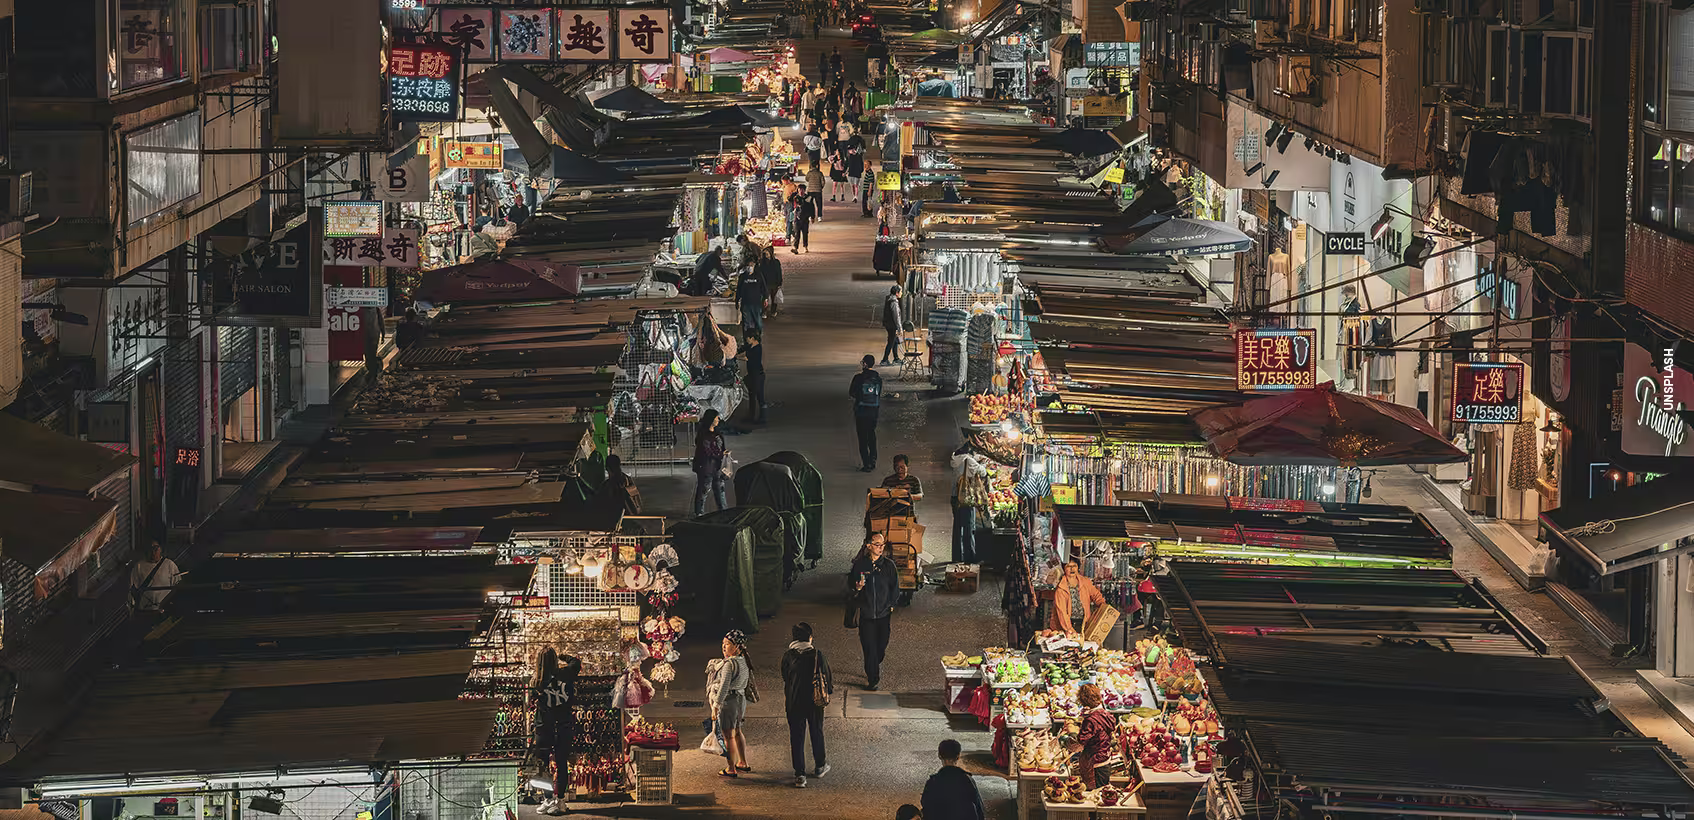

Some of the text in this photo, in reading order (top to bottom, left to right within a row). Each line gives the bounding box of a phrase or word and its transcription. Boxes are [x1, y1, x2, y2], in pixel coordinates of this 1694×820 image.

[389, 168, 407, 189] B
[1328, 237, 1364, 251] CYCLE
[1243, 335, 1290, 370] 美足樂
[1242, 371, 1311, 385] 91755993
[1455, 404, 1518, 420] 91755993
[1635, 376, 1685, 457] Triangle
